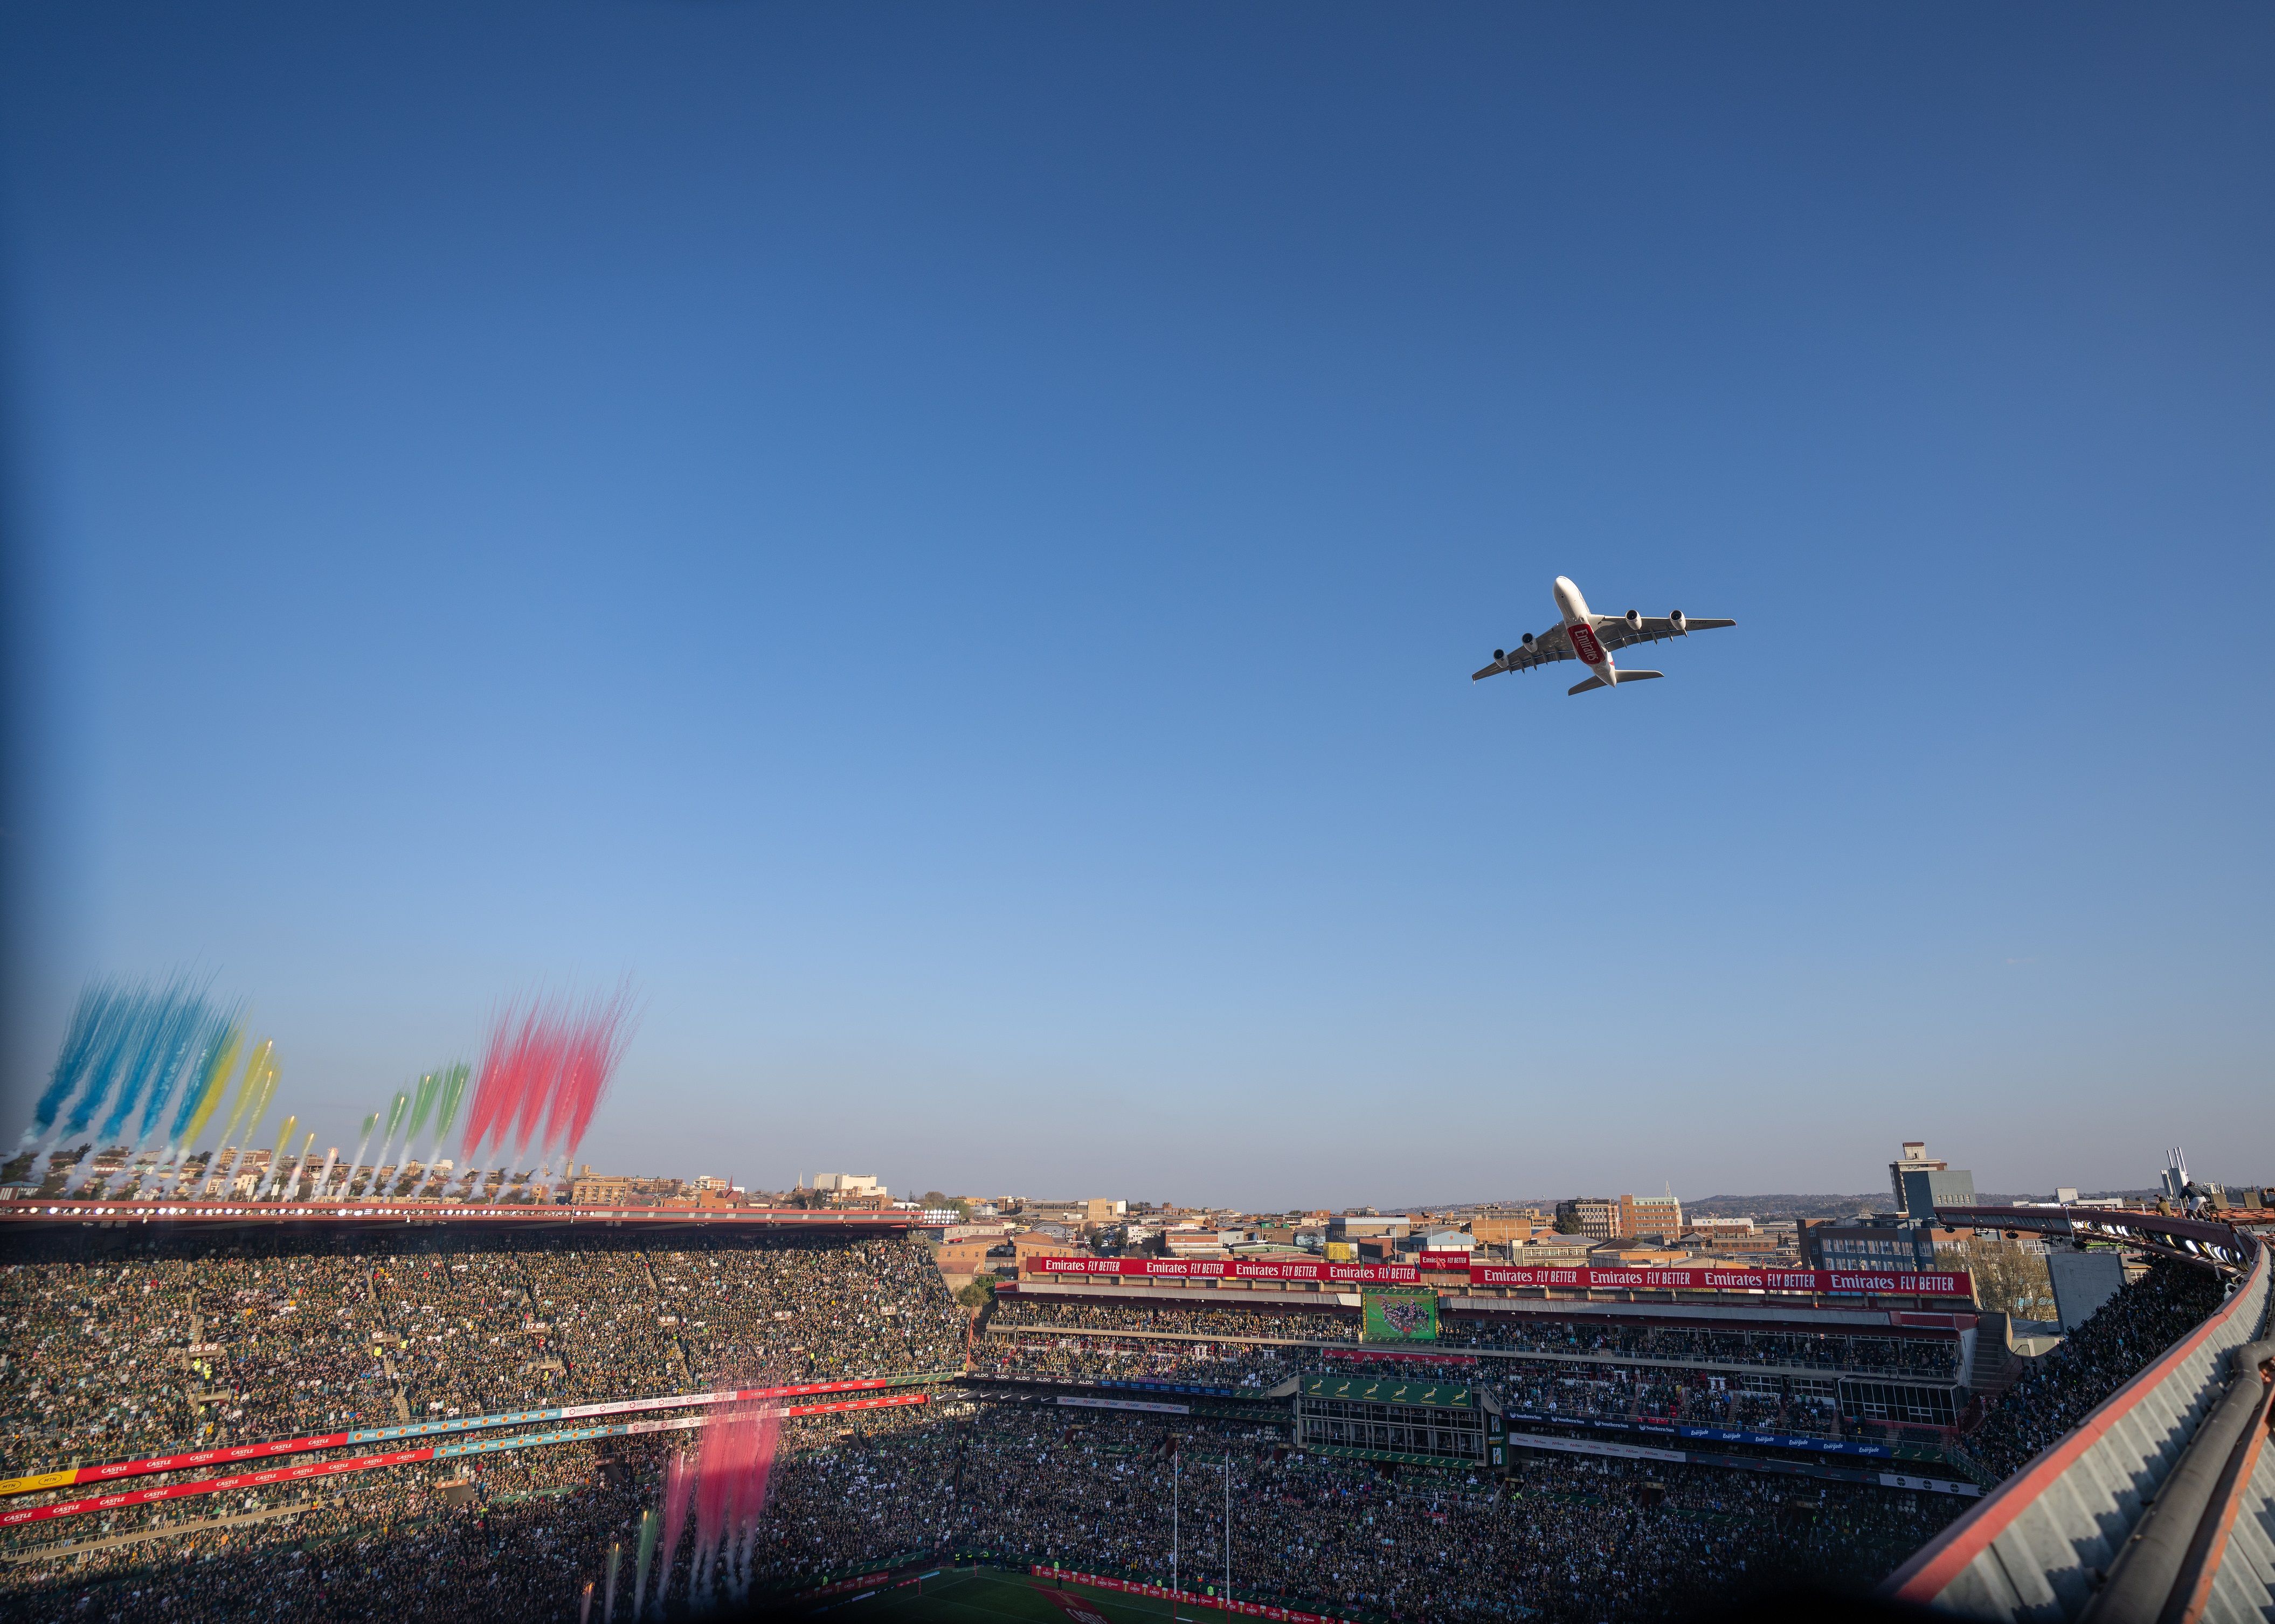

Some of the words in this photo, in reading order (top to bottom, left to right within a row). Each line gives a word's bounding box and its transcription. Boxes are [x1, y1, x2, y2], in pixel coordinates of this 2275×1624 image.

[1574, 628, 1598, 661] Emirates
[1046, 1260, 1084, 1270] Emirates
[1088, 1261, 1098, 1271] FLY
[1099, 1261, 1119, 1271] BETTER
[1147, 1262, 1187, 1273] Emirates
[1191, 1264, 1201, 1273] FLY
[1202, 1264, 1223, 1274] BETTER
[1236, 1265, 1278, 1275] Emirates
[1282, 1266, 1292, 1276] FLY
[1294, 1266, 1317, 1276] BETTER
[1330, 1266, 1374, 1279] Emirates
[1378, 1267, 1389, 1279] FLY
[1391, 1268, 1415, 1279] BETTER
[1484, 1270, 1532, 1281] Emirates
[1537, 1271, 1548, 1282] FLY
[1551, 1271, 1576, 1282] BETTER
[1590, 1271, 1642, 1283] Emirates
[1647, 1272, 1659, 1283] FLY
[1662, 1272, 1690, 1284] BETTER
[1705, 1273, 1762, 1286] Emirates
[1768, 1274, 1781, 1286] FLY
[1785, 1274, 1815, 1287] BETTER
[1831, 1275, 1894, 1289] Emirates
[1901, 1276, 1916, 1289] FLY
[1919, 1276, 1954, 1290] BETTER
[189, 1344, 203, 1352] 65
[231, 1448, 254, 1456] CASTLE
[146, 1459, 171, 1467] CASTLE
[102, 1466, 127, 1474] CASTLE
[143, 1490, 168, 1498] CASTLE
[99, 1497, 126, 1505] CASTLE
[53, 1504, 80, 1514] CASTLE
[4, 1512, 32, 1522] CASTLE
